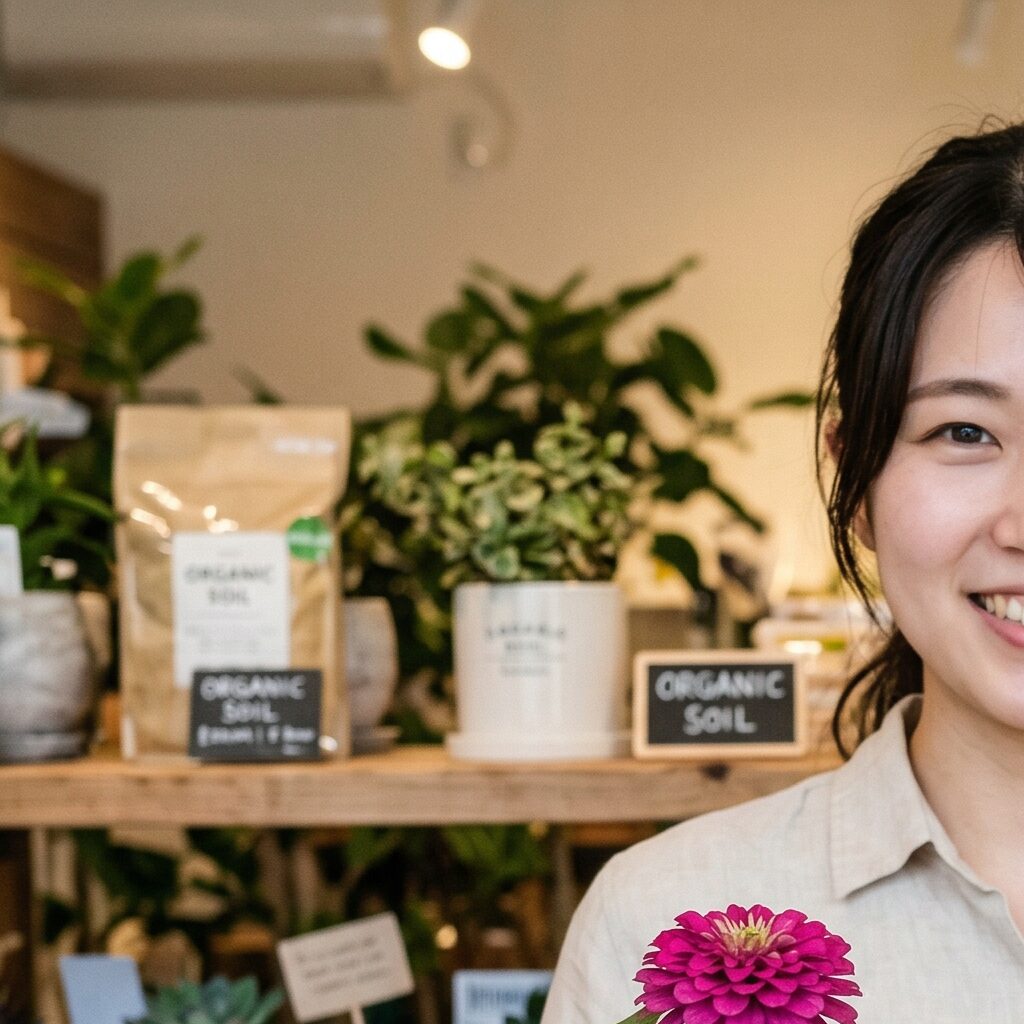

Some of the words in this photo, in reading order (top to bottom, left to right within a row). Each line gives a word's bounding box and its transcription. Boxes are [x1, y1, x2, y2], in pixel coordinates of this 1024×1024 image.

[201, 674, 307, 701] ORGANIC
[655, 669, 787, 701] ORGANIC
[221, 699, 280, 725] SOIL
[682, 702, 758, 736] SOIL
